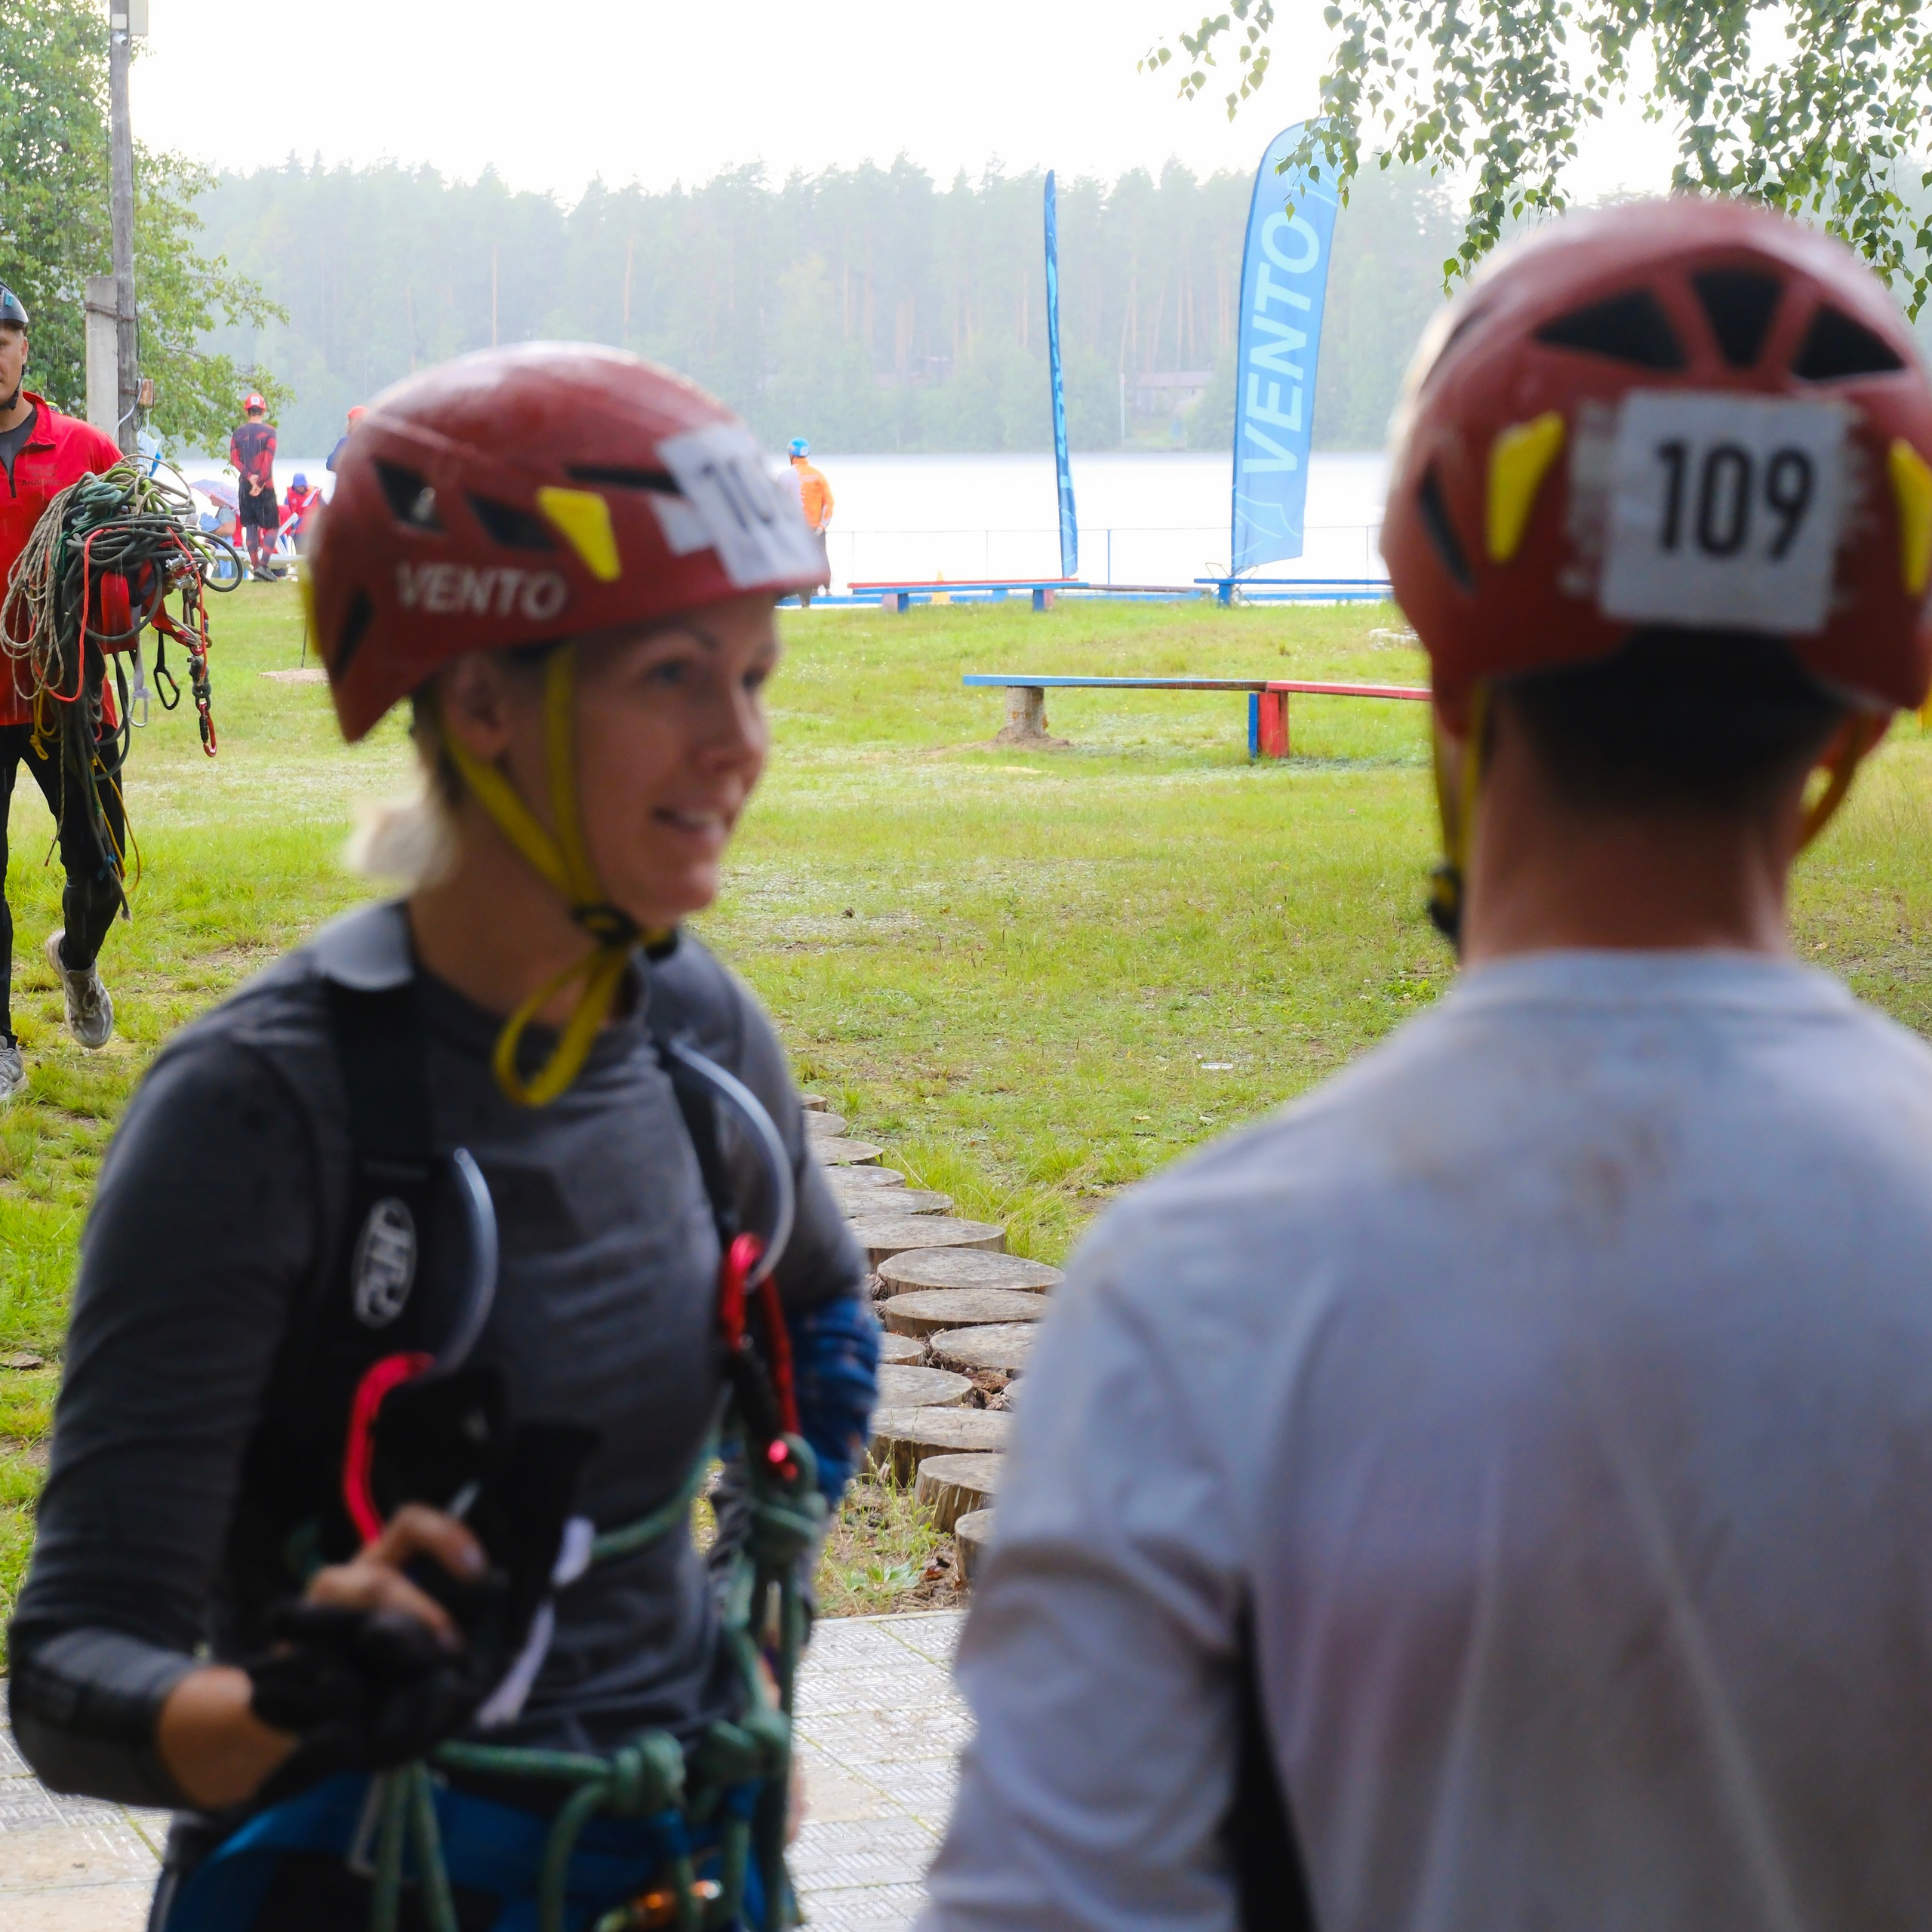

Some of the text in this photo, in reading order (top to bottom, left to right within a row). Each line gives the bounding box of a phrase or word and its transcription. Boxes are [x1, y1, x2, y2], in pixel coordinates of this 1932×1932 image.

[1242, 211, 1320, 473] VENTO
[1655, 441, 1815, 561] 109
[395, 561, 567, 620] VENTO
